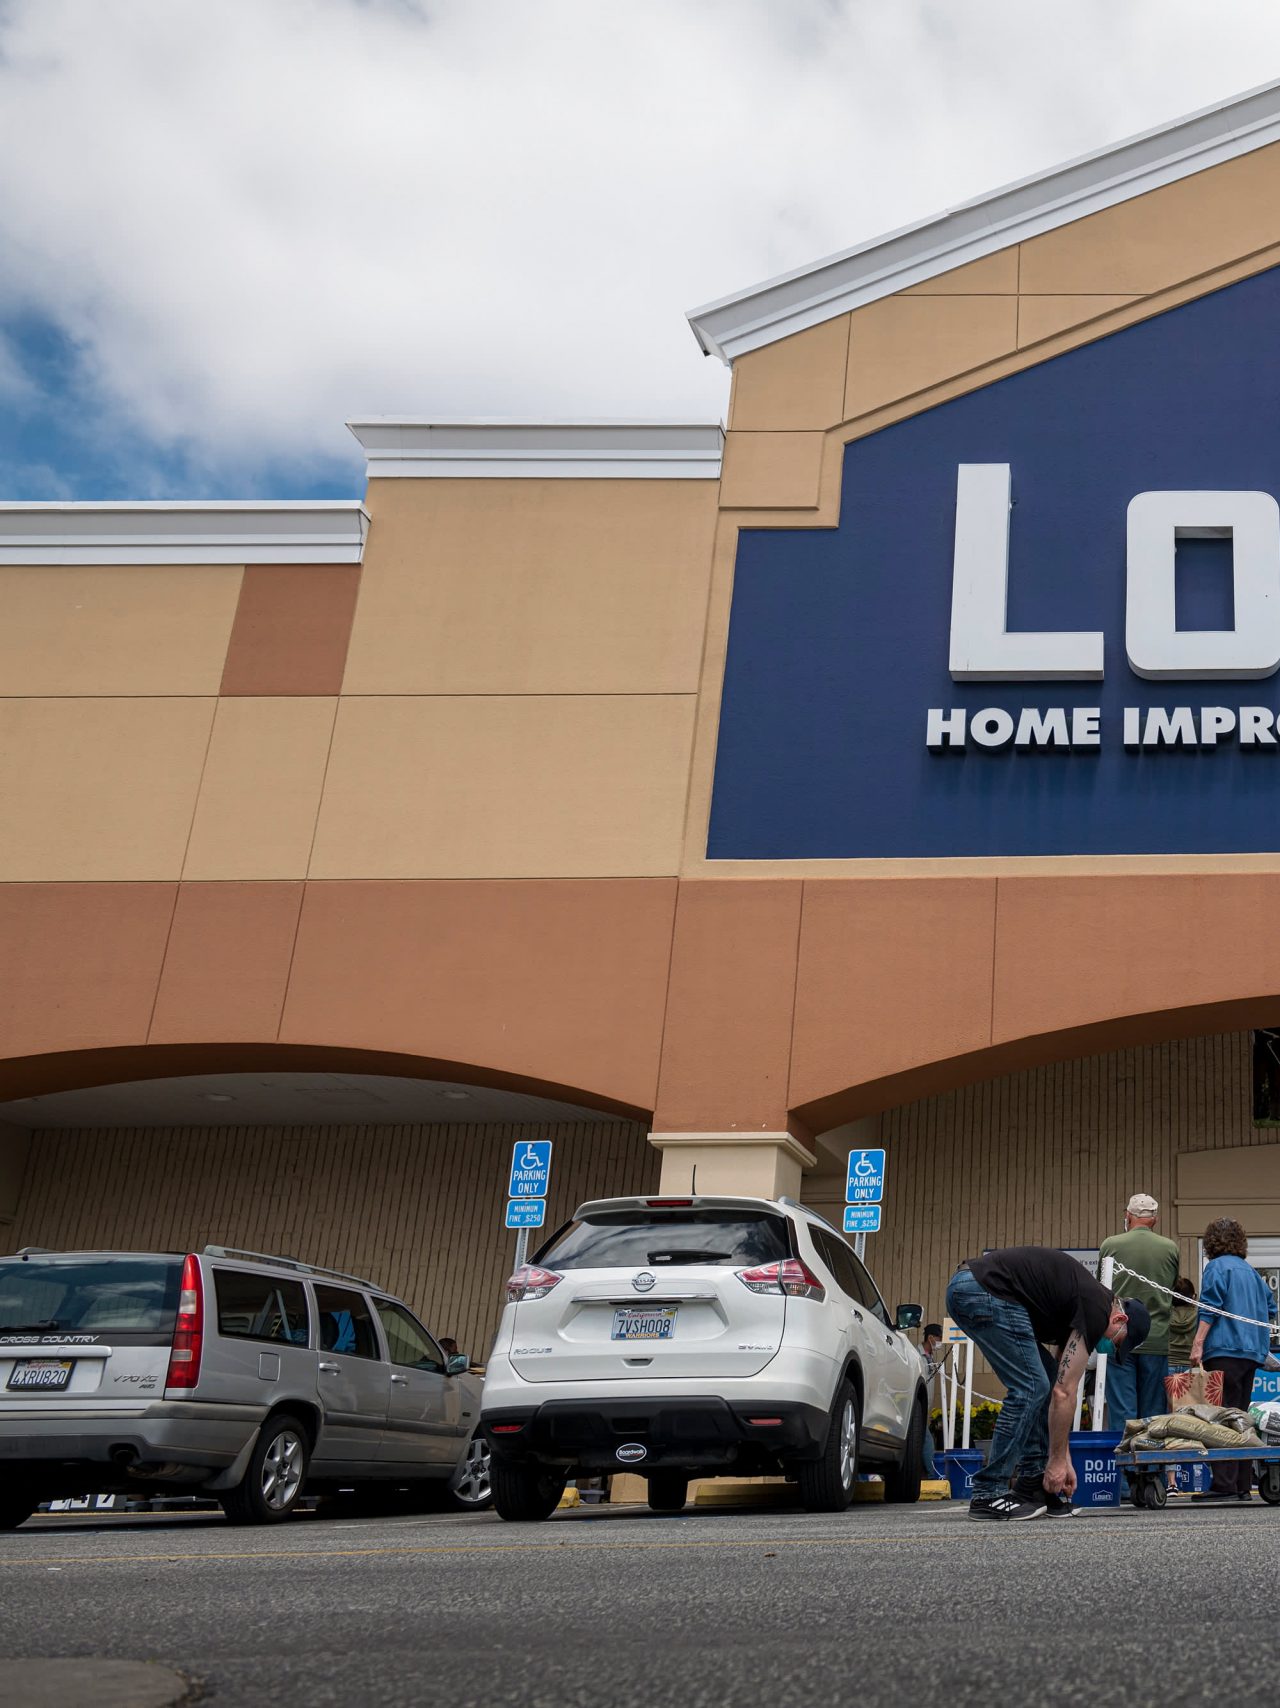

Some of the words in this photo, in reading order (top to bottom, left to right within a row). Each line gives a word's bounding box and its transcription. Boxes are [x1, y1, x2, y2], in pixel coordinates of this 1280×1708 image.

[926, 706, 1101, 750] HOME
[513, 1170, 546, 1181] PARKING
[849, 1176, 881, 1187] PARKING
[518, 1183, 539, 1193] ONLY
[854, 1188, 874, 1199] ONLY
[525, 1214, 541, 1222] $250
[618, 1319, 671, 1333] 7VSH008
[10, 1370, 67, 1385] 4XRU820
[113, 1375, 139, 1383] V70
[141, 1375, 158, 1383] XC
[1085, 1460, 1103, 1471] DO
[1107, 1460, 1117, 1472] IT
[1085, 1473, 1117, 1483] RIGHT
